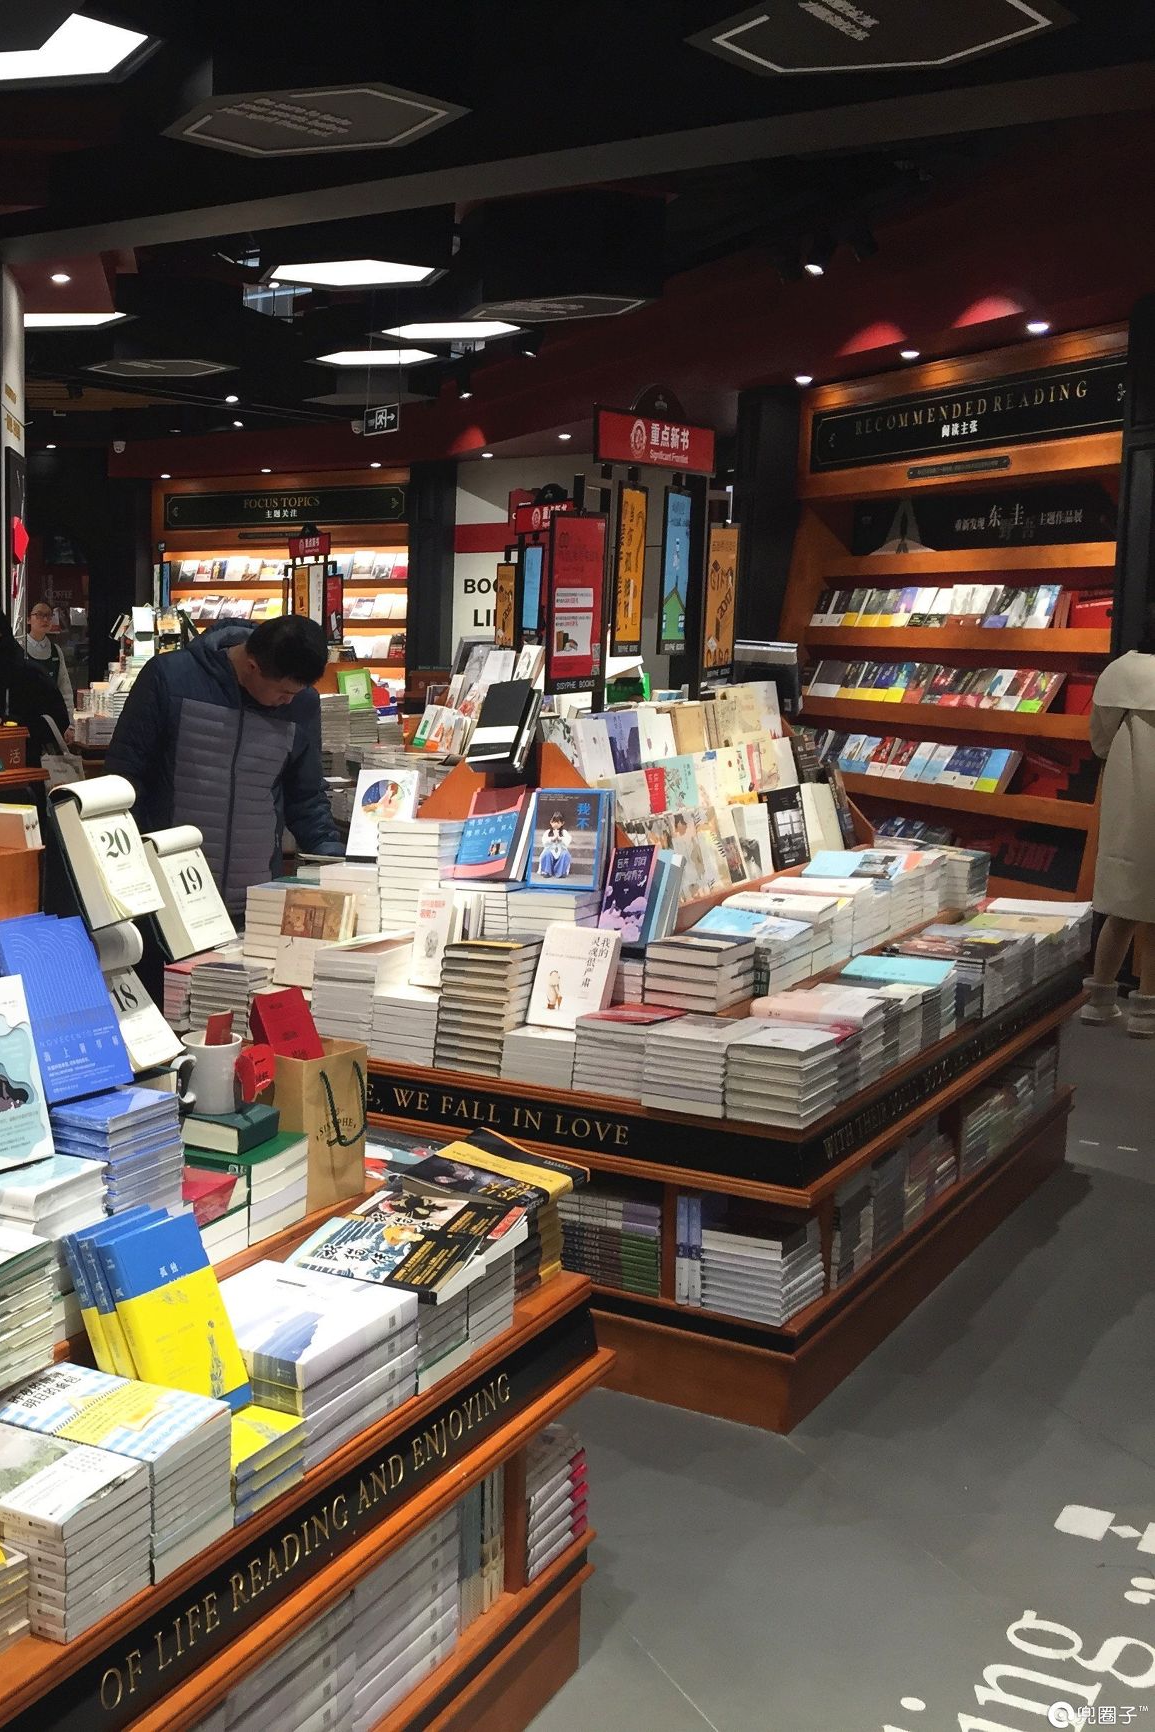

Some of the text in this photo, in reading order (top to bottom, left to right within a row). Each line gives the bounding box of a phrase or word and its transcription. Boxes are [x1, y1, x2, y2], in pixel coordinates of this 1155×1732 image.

[855, 380, 1088, 436] RECOMMENDED READING
[650, 422, 690, 451] 重点新书
[941, 420, 978, 438] 阅读主张
[244, 496, 321, 509] FOCUS TOPICS
[100, 826, 132, 859] 20
[177, 865, 204, 897] 19
[600, 936, 611, 959] 我的
[110, 981, 139, 1013] 18
[393, 1086, 432, 1113] WE
[440, 1097, 507, 1128] FALL
[513, 1108, 543, 1132] IN
[555, 1115, 631, 1148] LOVE
[100, 1373, 511, 1711] OF LIFE READING AND ENJOYING
